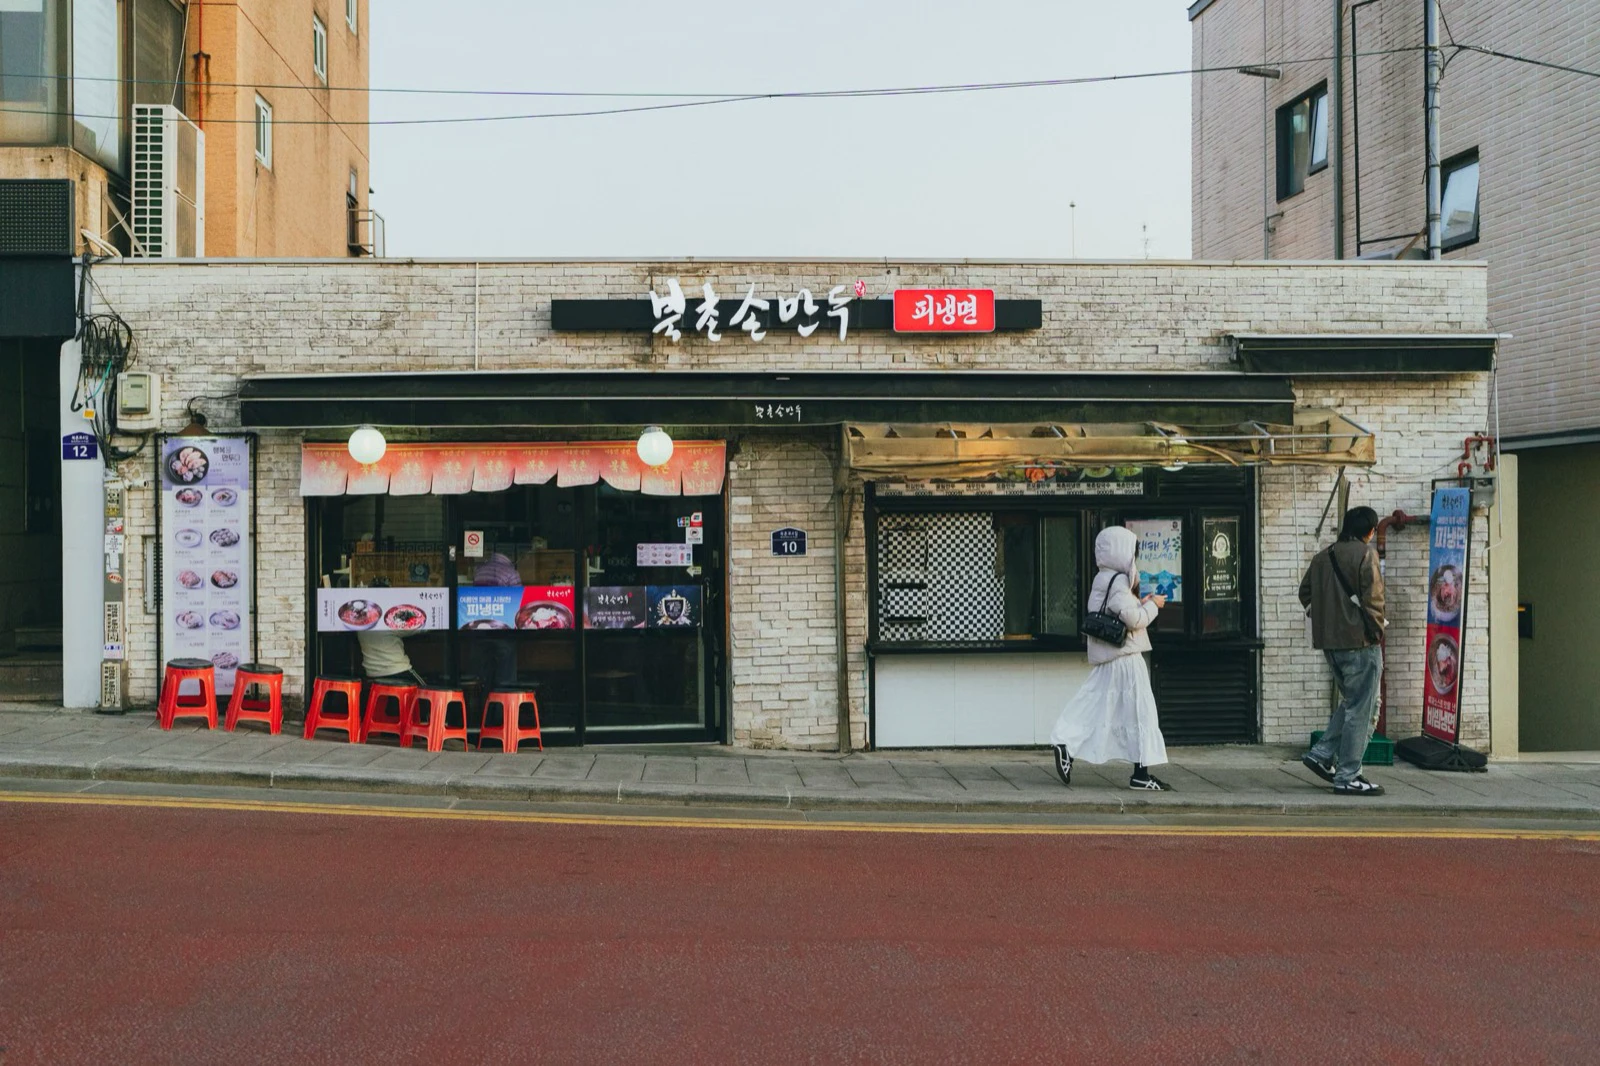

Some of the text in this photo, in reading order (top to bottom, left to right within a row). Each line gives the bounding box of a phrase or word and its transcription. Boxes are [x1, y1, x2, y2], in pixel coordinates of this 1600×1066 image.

[649, 278, 852, 342] 북촌손만두
[911, 294, 978, 326] 피냉면
[755, 404, 801, 422] 북촌손만두
[72, 445, 88, 457] 12
[692, 460, 711, 475] 북촌
[782, 541, 797, 553] 10
[1435, 527, 1466, 549] 피냉면
[467, 603, 504, 616] 피냉면
[1427, 705, 1455, 734] 비빔냉면
